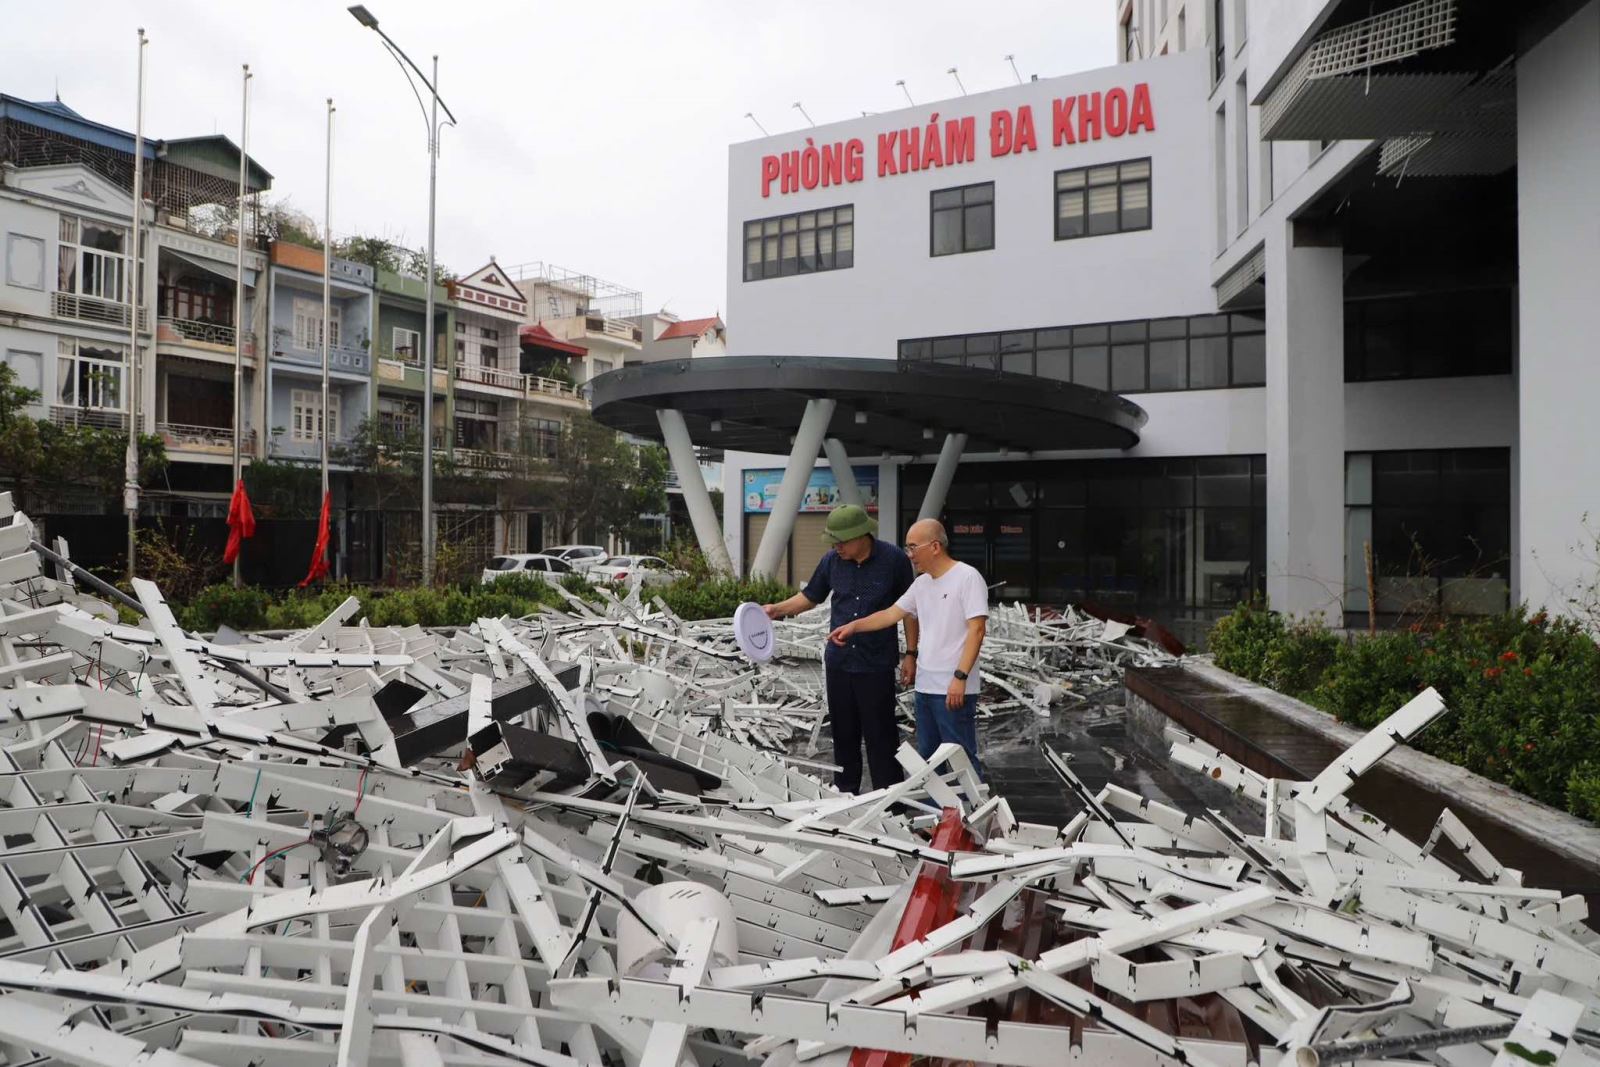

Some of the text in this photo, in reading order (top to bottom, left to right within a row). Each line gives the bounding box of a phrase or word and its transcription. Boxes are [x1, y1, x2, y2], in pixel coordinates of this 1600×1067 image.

[762, 83, 1155, 197] PHÒNG KHÁM ĐA KHOA
